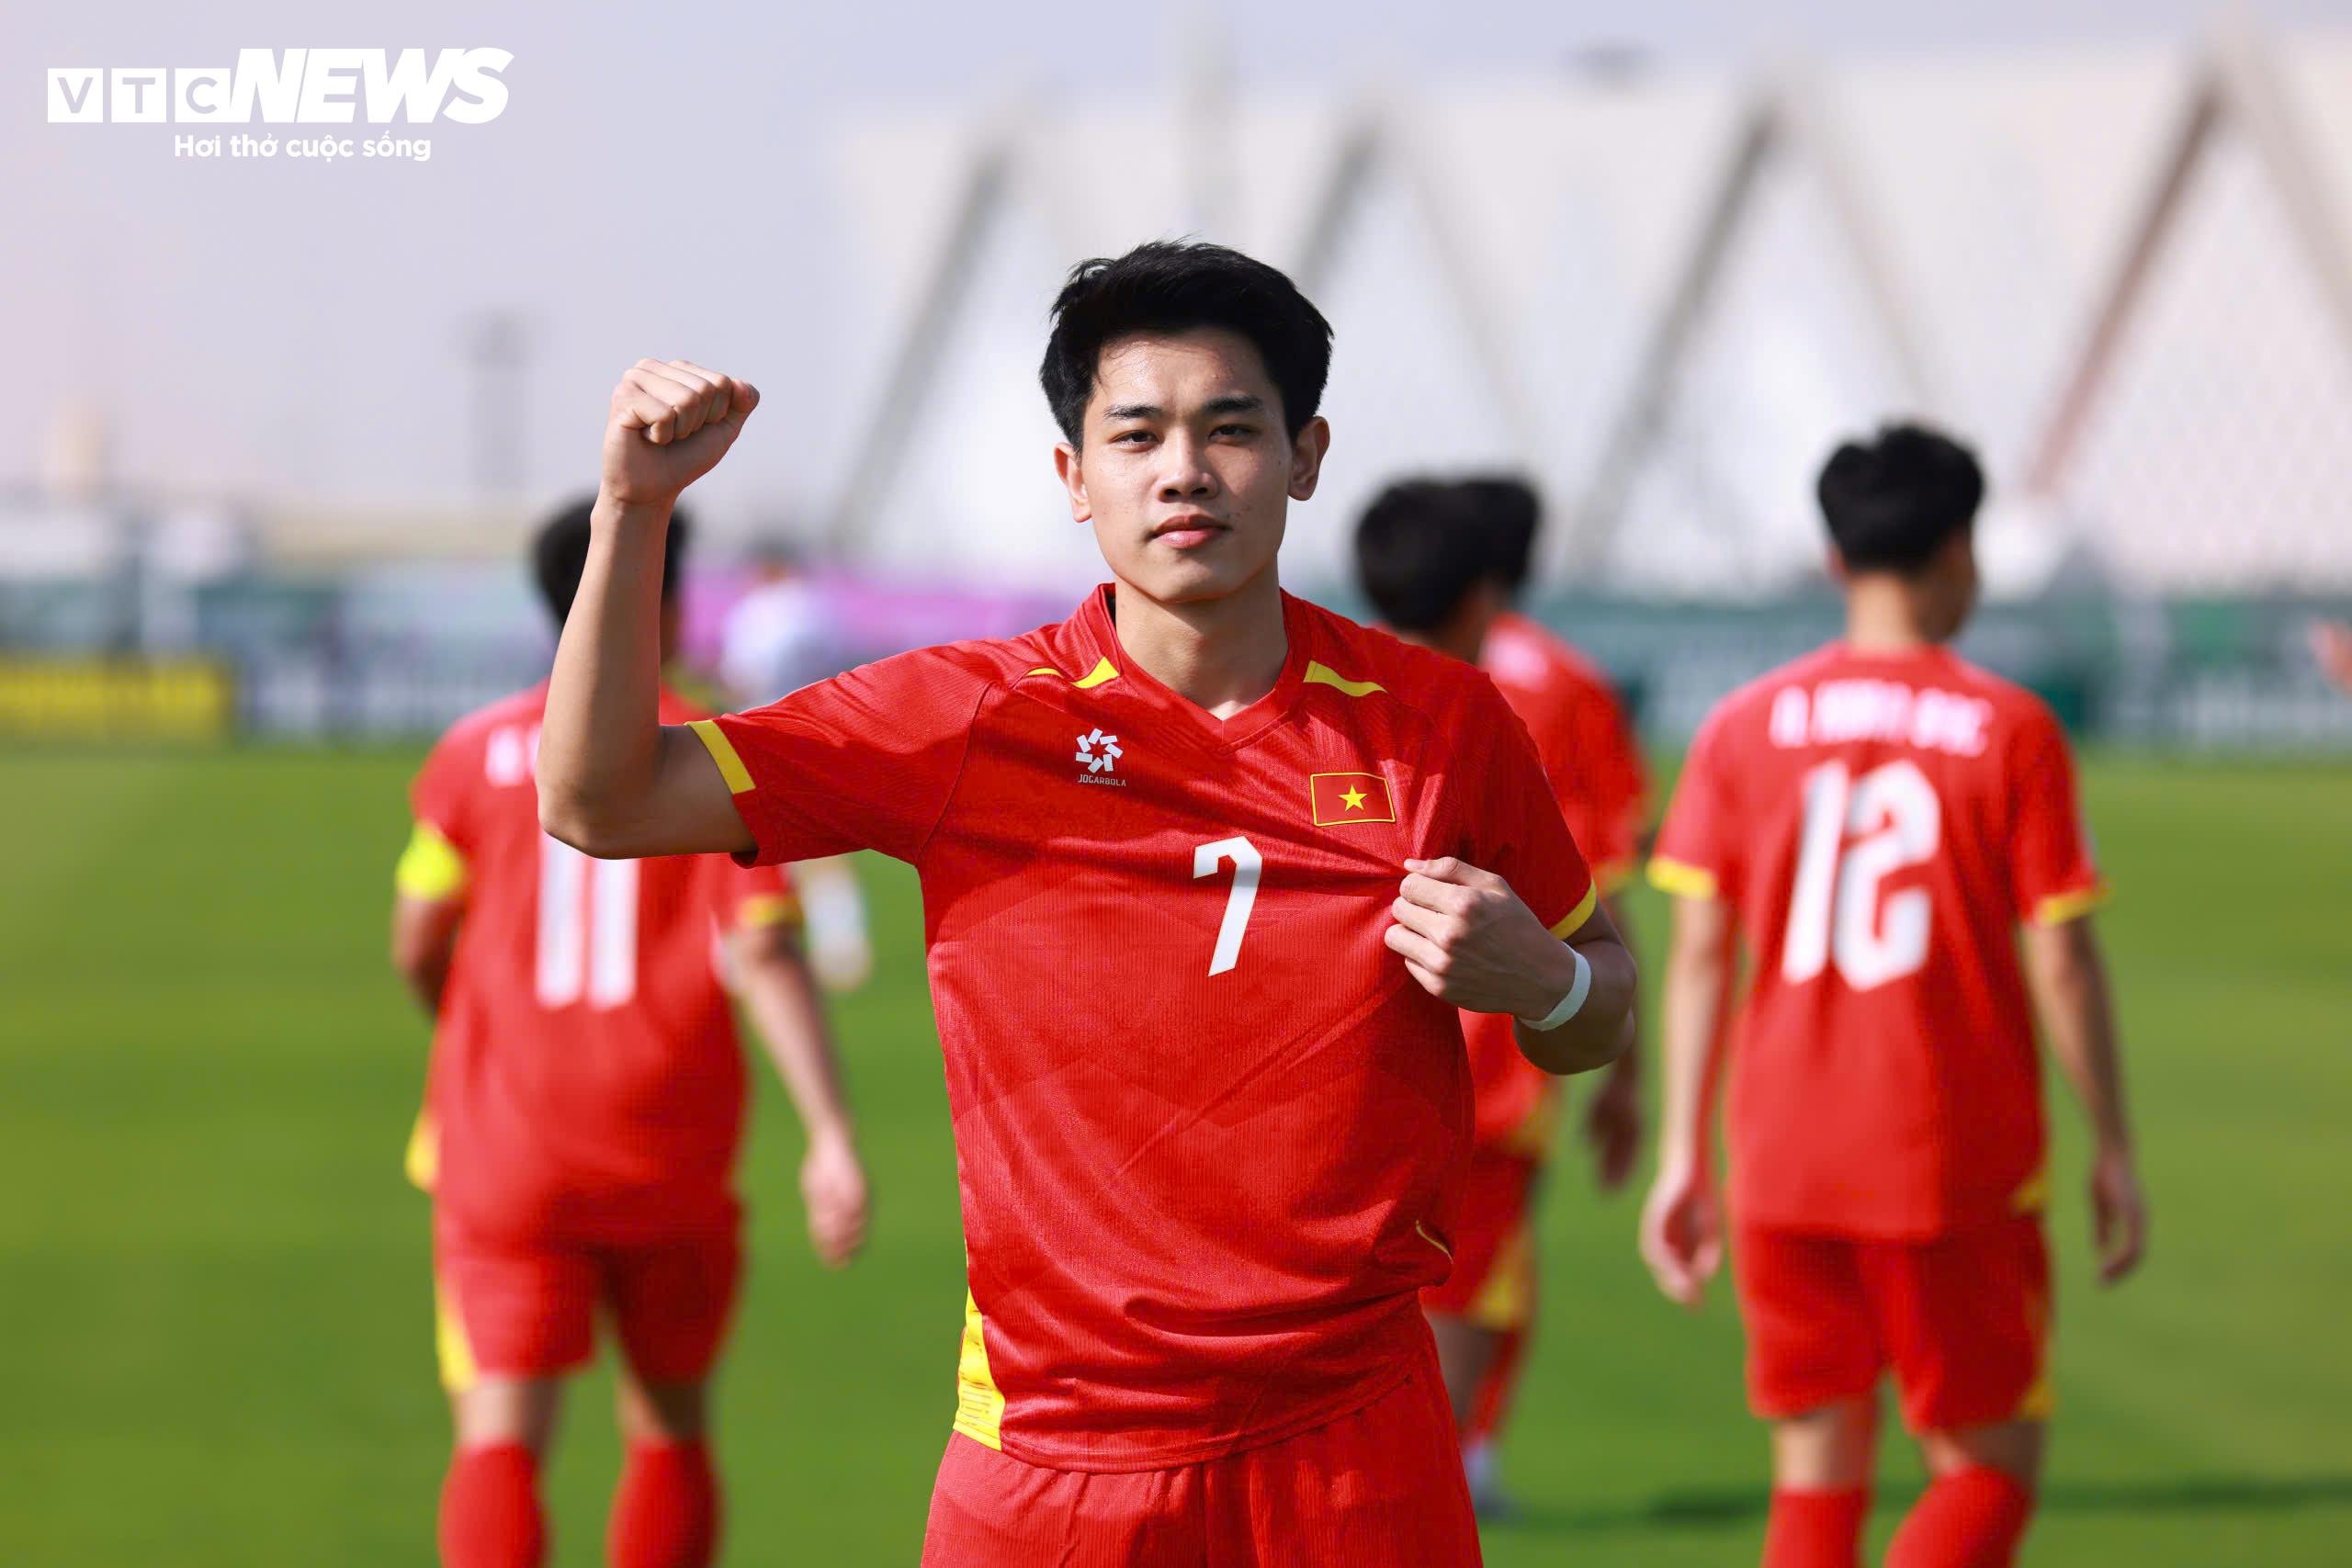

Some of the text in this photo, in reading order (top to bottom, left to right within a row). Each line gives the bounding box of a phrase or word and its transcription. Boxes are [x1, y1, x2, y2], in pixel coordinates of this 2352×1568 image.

[1078, 773, 1126, 786] JOGARBOLA
[536, 829, 639, 1010] 11
[1193, 836, 1262, 976] 7
[1781, 759, 1941, 992] 12
